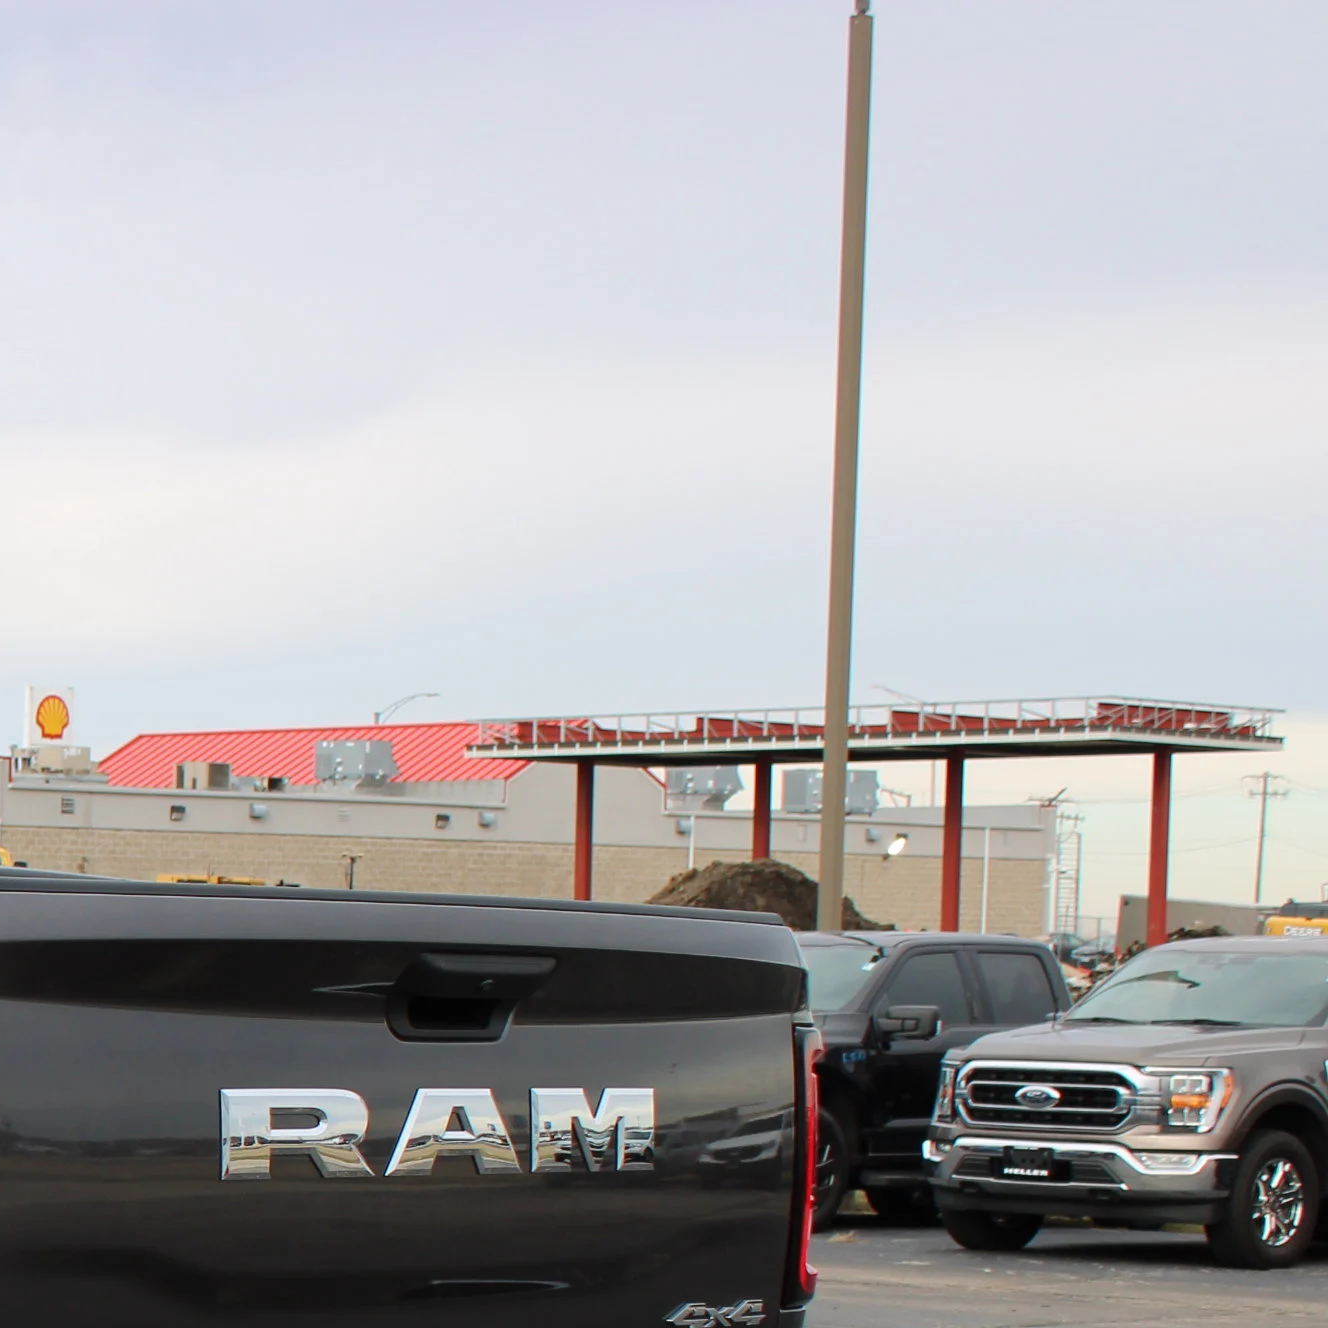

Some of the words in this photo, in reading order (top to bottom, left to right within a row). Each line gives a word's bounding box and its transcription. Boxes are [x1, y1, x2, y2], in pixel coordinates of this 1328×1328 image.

[1284, 926, 1322, 937] DEERE
[220, 1087, 655, 1180] RAM
[1003, 1167, 1049, 1177] HELLER
